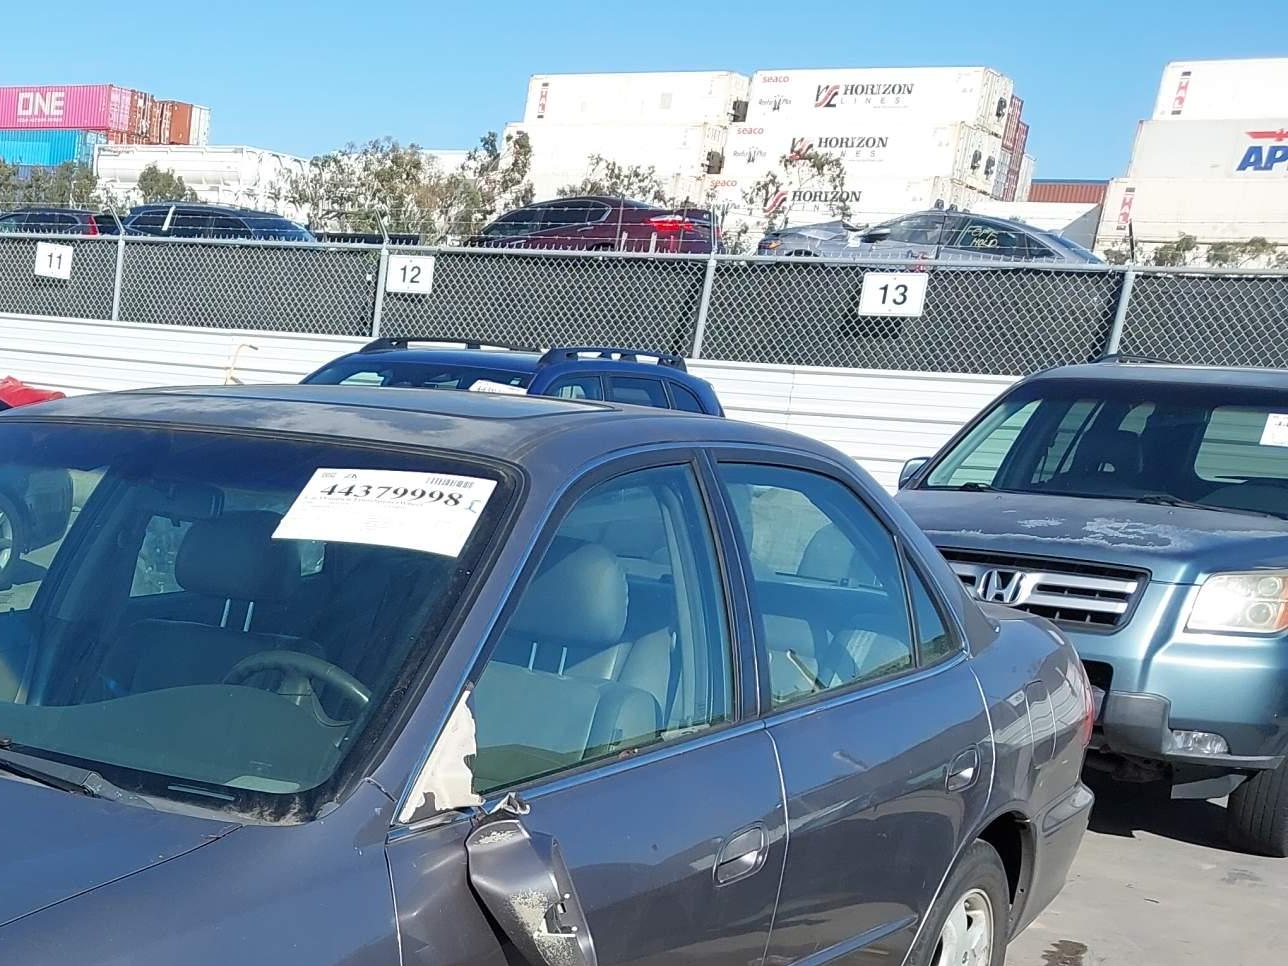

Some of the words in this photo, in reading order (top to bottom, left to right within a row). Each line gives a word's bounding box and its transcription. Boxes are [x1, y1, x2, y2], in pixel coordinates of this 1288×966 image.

[762, 75, 790, 83] seaco
[842, 83, 914, 96] HORIZON
[16, 91, 65, 116] ONE
[840, 97, 901, 105] LINES
[736, 127, 764, 135] seaco
[817, 136, 889, 148] HORIZON
[1235, 145, 1288, 171] AP
[710, 179, 737, 187] seaco
[791, 190, 862, 203] HORIZON
[47, 253, 62, 270] 11
[400, 265, 422, 284] 12
[878, 284, 909, 306] 13
[320, 483, 464, 507] 44379998
